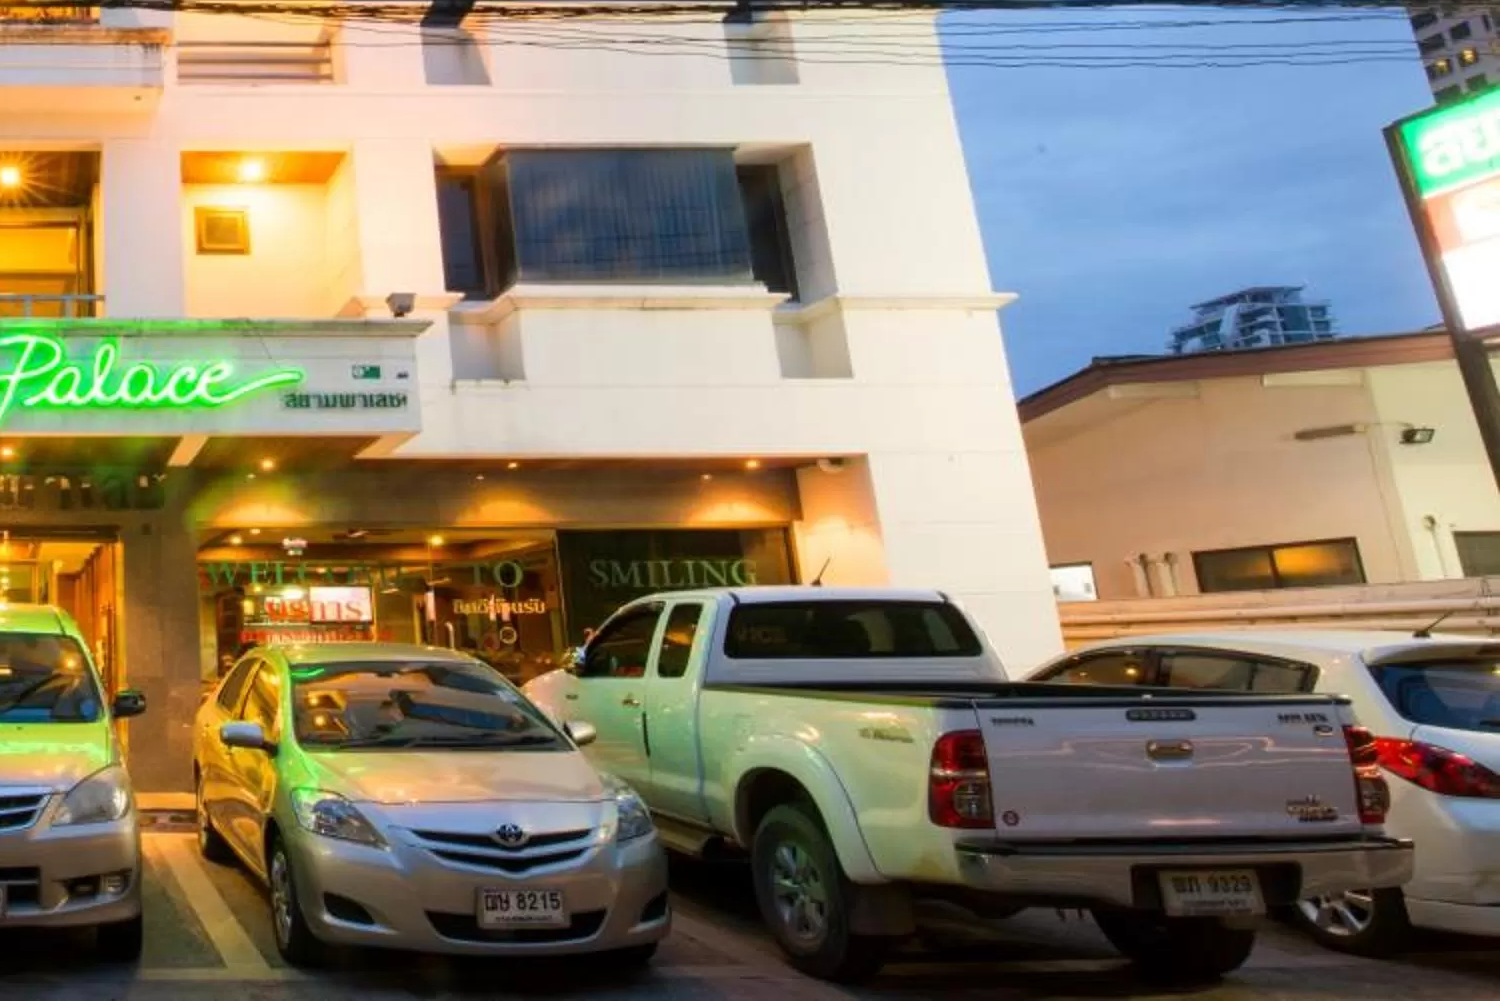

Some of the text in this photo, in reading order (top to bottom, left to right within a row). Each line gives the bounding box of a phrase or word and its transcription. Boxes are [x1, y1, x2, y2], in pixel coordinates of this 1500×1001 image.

[467, 560, 524, 588] TO
[589, 559, 758, 588] SMILING
[516, 892, 561, 911] 8215
